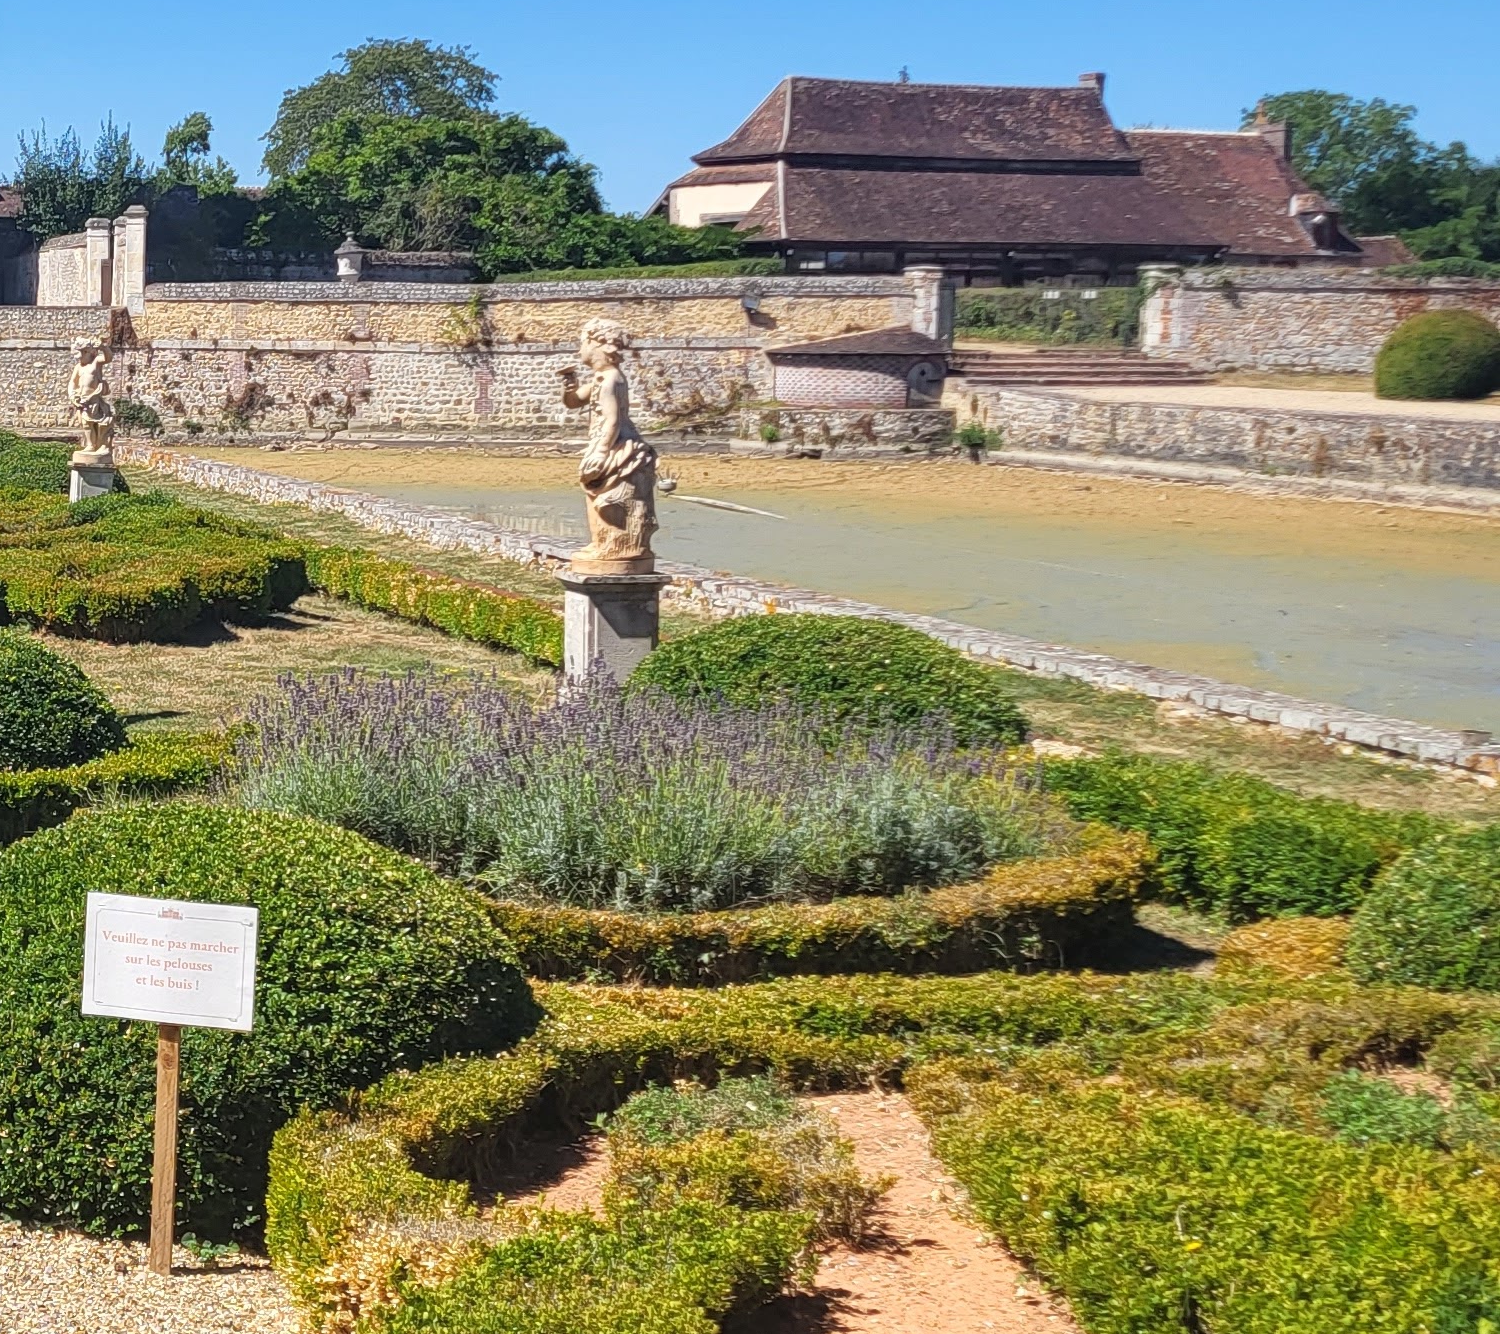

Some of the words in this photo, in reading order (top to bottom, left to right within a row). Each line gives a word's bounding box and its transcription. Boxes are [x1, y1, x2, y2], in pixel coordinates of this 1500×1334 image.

[102, 930, 149, 946] Veuillez
[151, 939, 165, 947] ne
[167, 941, 187, 951] pas
[190, 942, 239, 954] marcher
[125, 955, 144, 965] sur
[146, 955, 161, 967] les
[163, 958, 213, 972] pelouses
[135, 976, 147, 986] et
[150, 975, 165, 987] les
[167, 977, 193, 990] buis
